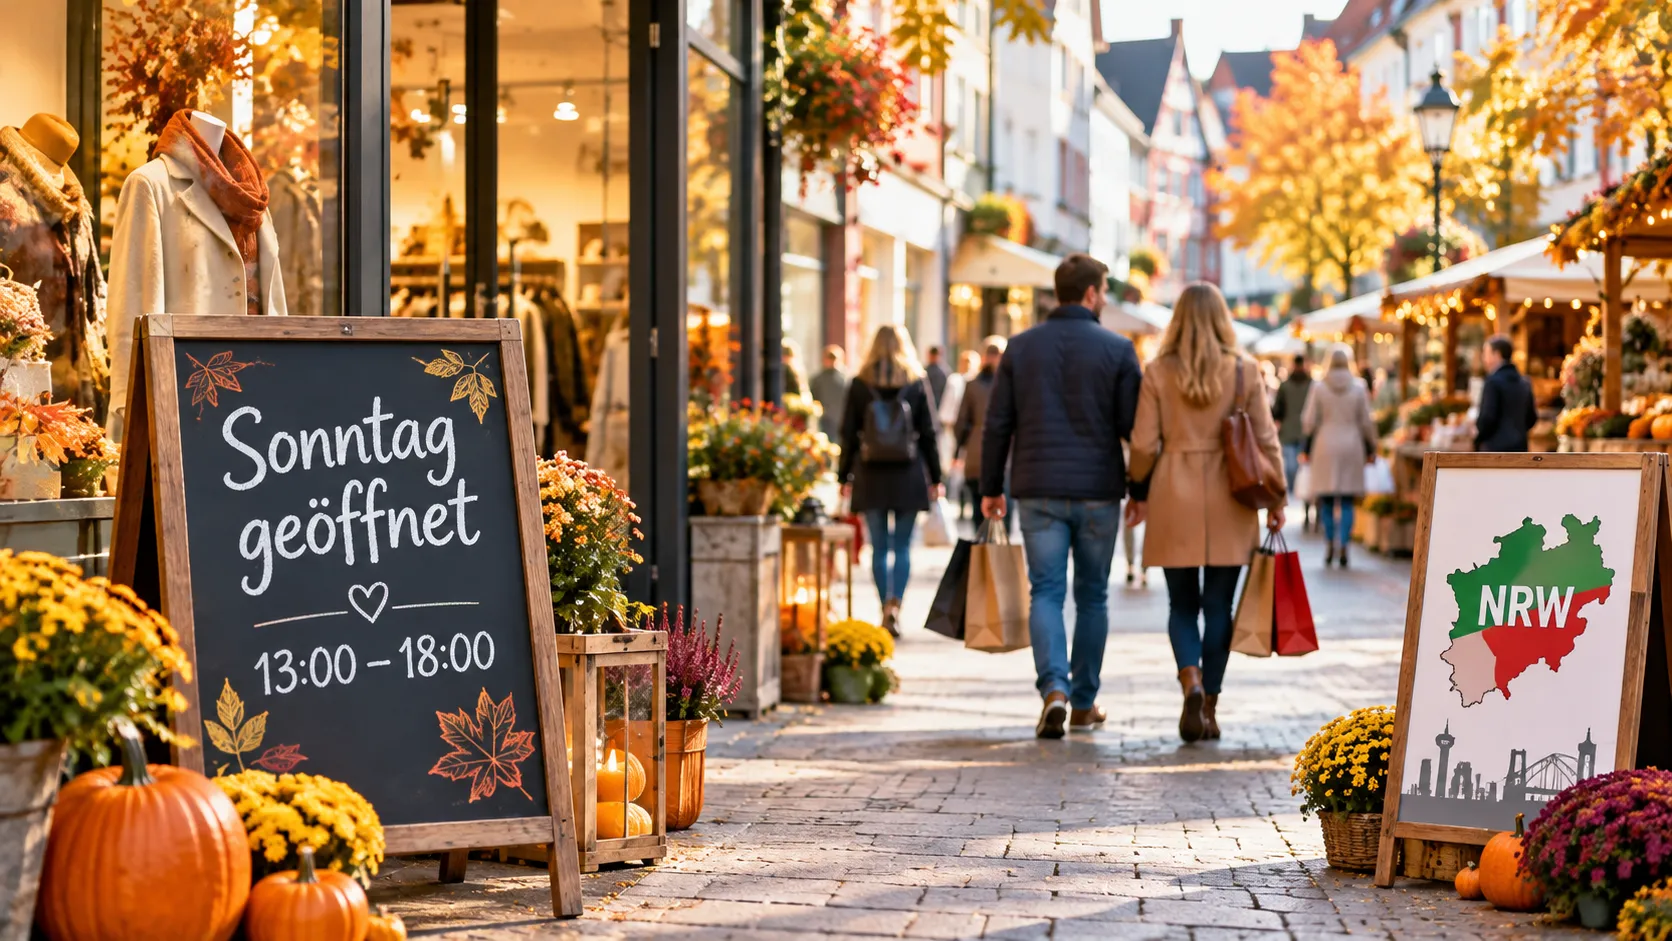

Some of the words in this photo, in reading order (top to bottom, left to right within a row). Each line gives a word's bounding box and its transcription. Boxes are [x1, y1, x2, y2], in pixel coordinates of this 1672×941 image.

[222, 396, 456, 492] Sonntag
[239, 478, 482, 597] geöffnet
[1478, 585, 1575, 629] NRW
[253, 644, 357, 696] 13:00
[398, 630, 495, 679] 18:00
